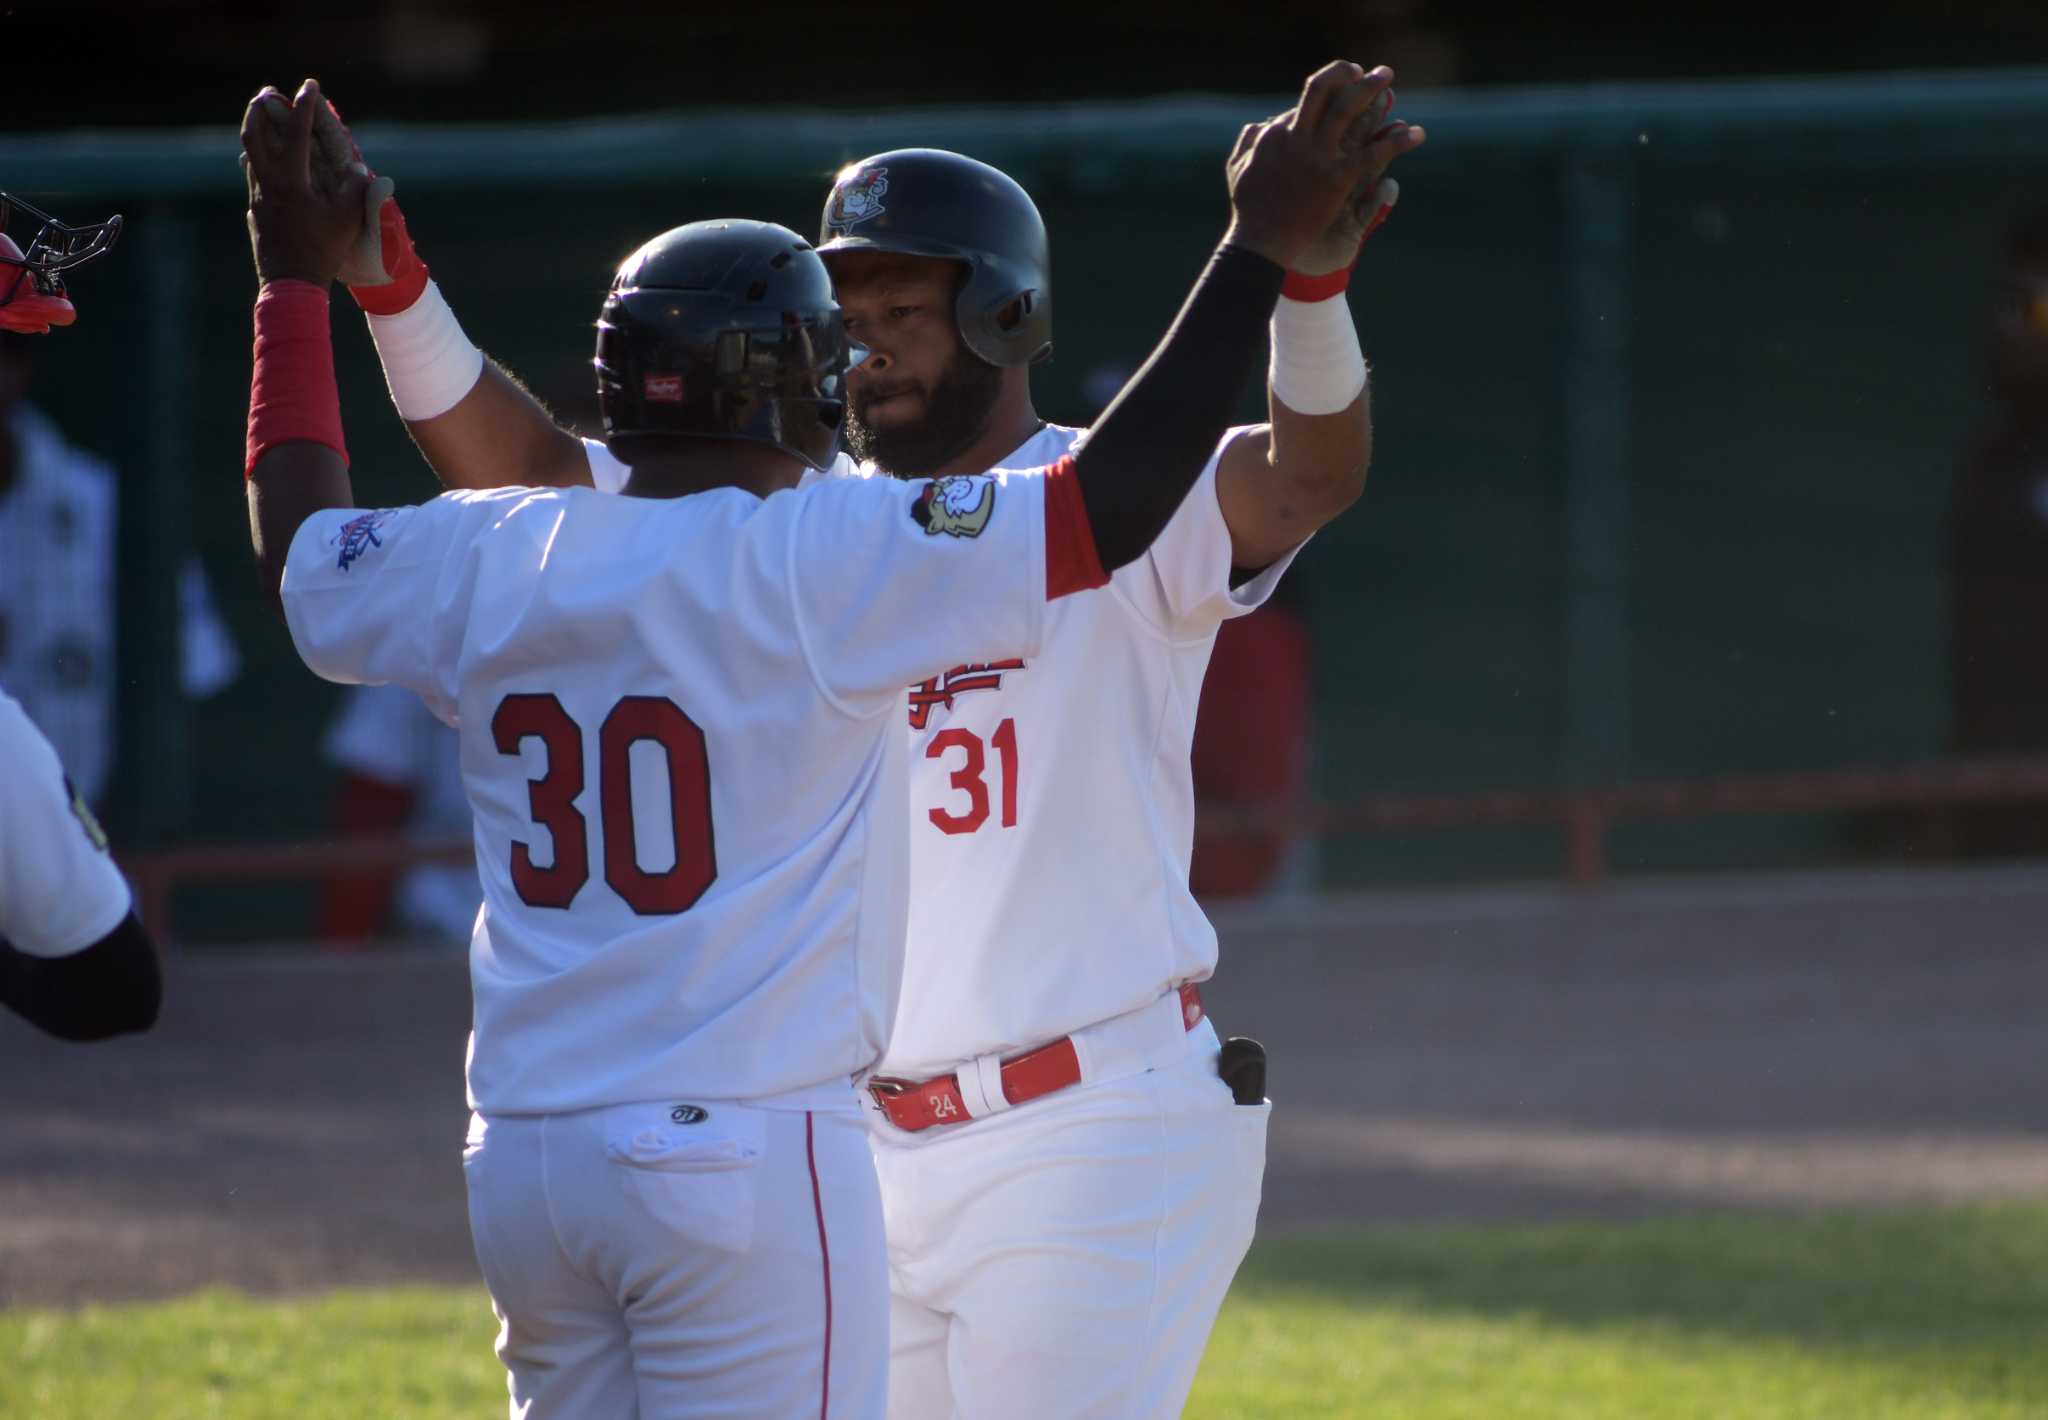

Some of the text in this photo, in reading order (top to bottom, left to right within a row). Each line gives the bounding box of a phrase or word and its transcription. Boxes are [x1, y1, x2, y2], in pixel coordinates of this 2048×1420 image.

[491, 692, 718, 917] 30
[925, 717, 1018, 835] 31
[928, 1093, 958, 1119] 24
